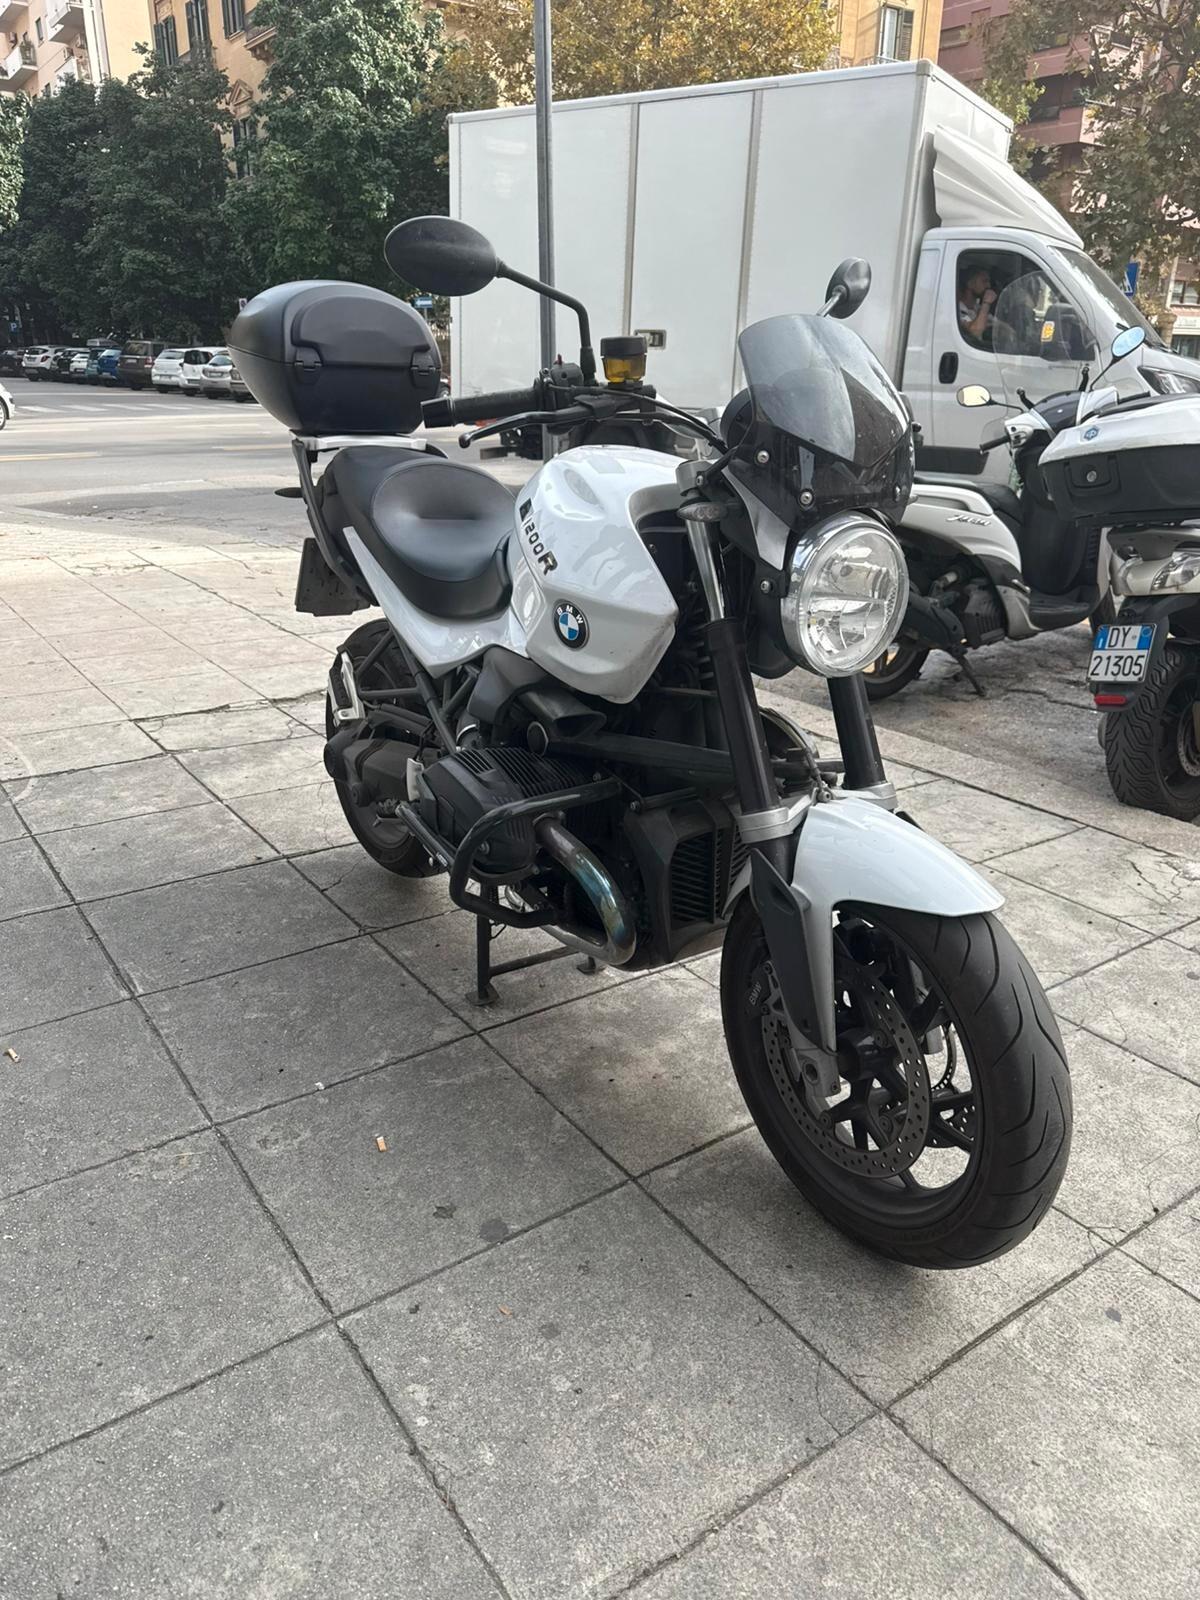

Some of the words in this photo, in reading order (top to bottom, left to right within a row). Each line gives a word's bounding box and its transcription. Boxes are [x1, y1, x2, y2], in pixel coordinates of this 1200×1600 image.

[556, 604, 584, 624] BMW
[1108, 627, 1132, 648] DY
[1090, 655, 1146, 677] 21305
